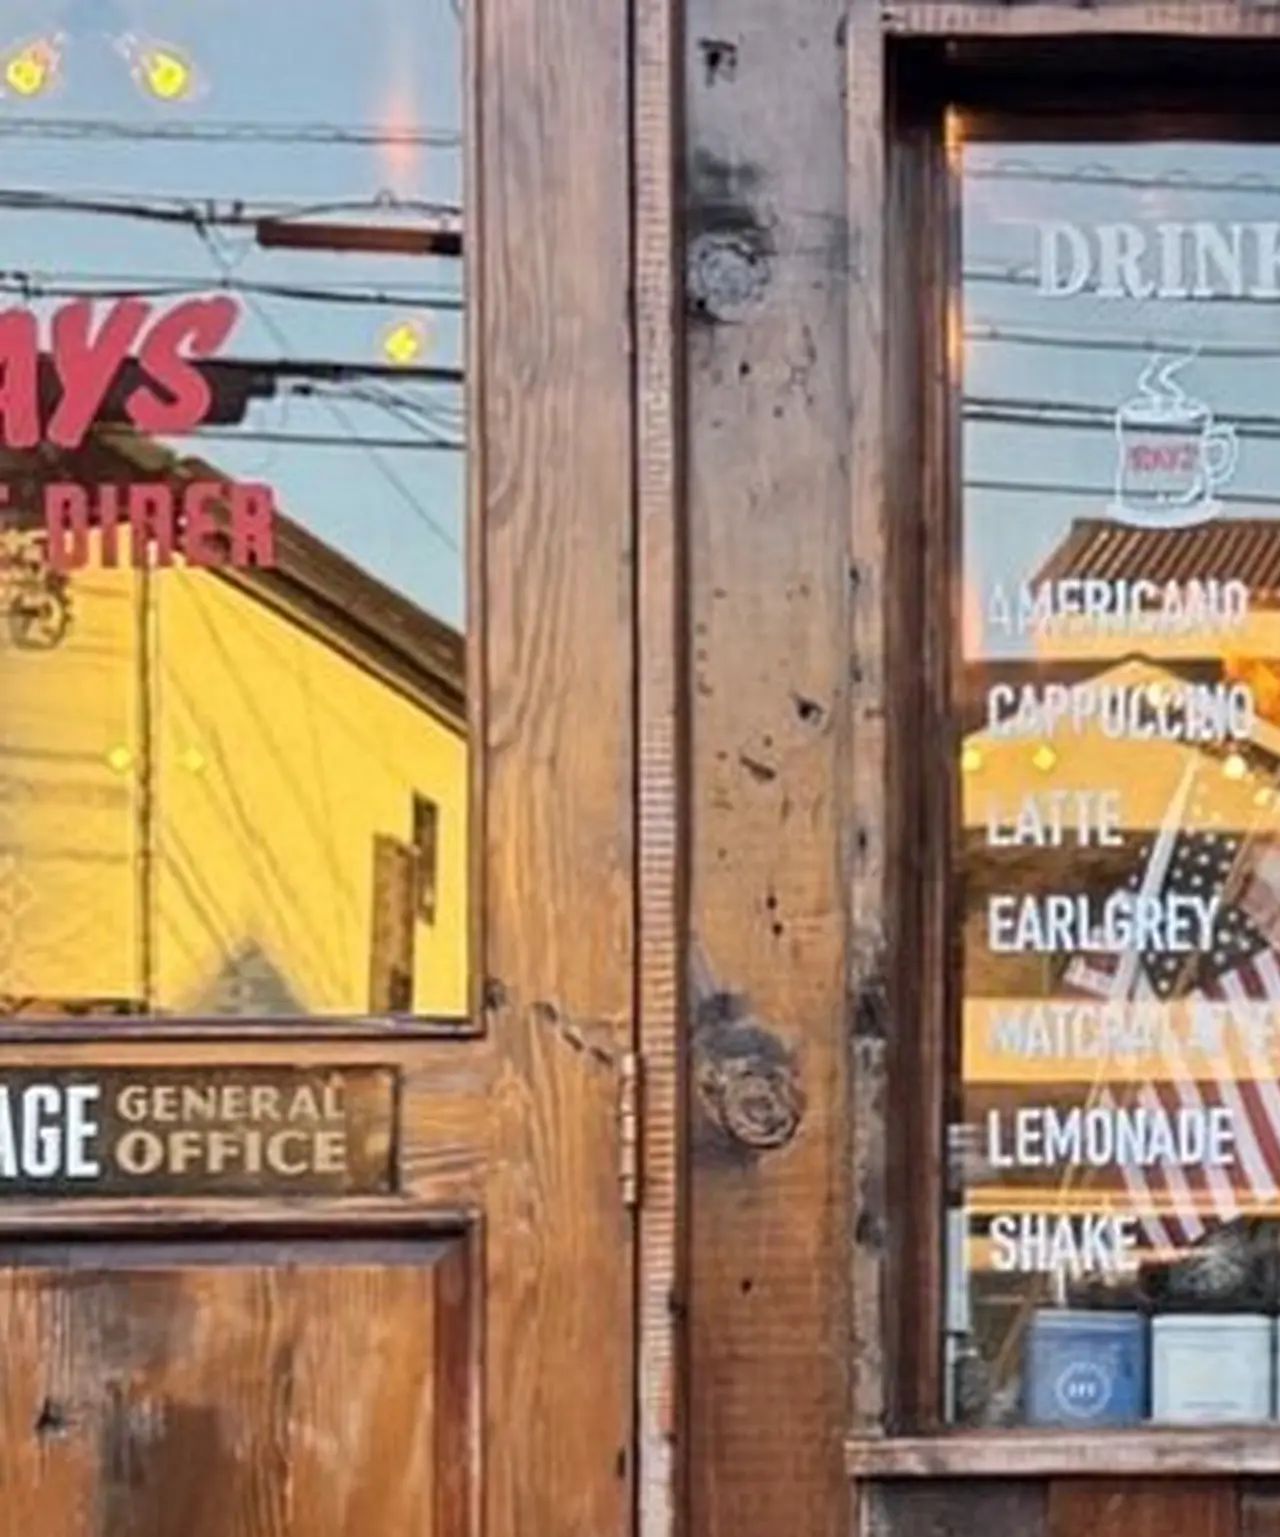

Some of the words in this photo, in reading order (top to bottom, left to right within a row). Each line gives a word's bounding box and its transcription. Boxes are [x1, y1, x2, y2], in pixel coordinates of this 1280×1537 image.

[46, 483, 277, 572] DINER
[986, 579, 1249, 640] AMERICANO
[986, 683, 1254, 741] CAPPUCCINO
[986, 788, 1124, 846] LATTE
[117, 1085, 344, 1122] GENERAL
[115, 1130, 347, 1174] OFFICE
[986, 1109, 1234, 1168] LEMONADE
[987, 1213, 1141, 1273] SHAKE
